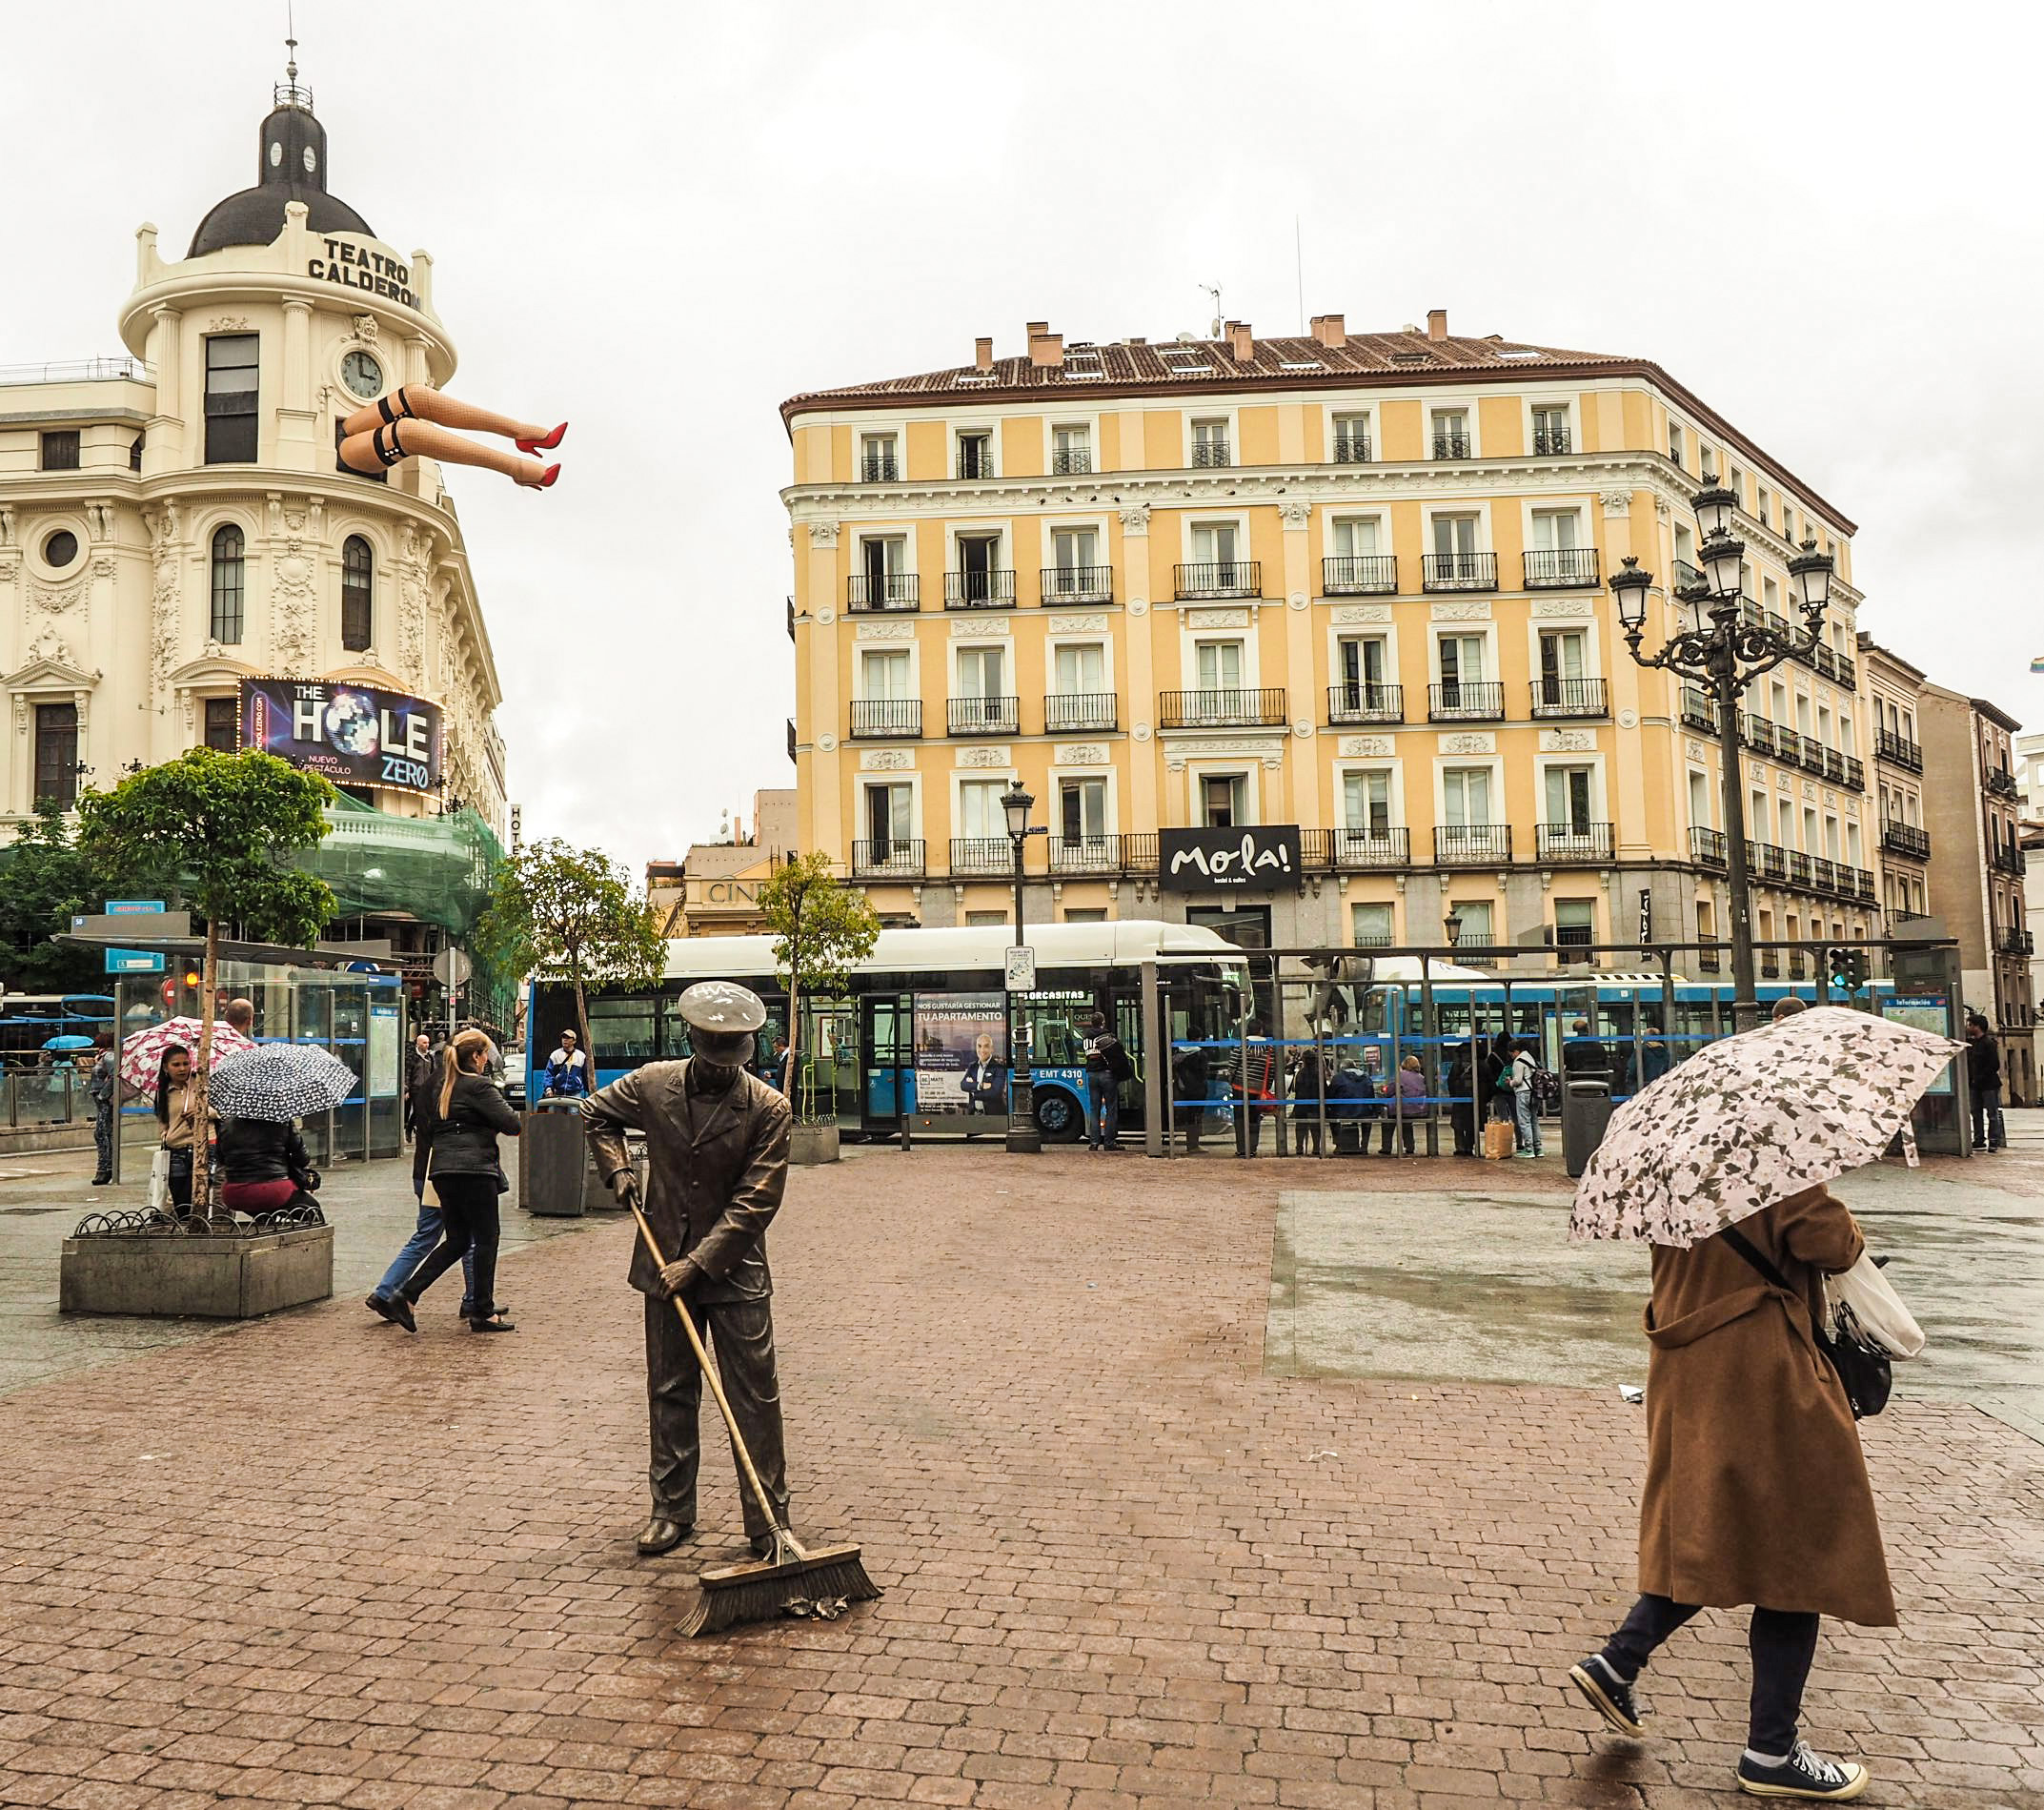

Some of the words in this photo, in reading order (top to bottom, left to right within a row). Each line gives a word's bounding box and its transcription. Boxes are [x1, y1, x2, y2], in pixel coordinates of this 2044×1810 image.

[324, 238, 408, 285] TEATRO
[309, 259, 420, 311] CALDERON
[294, 686, 323, 700] THE
[293, 694, 429, 763] HOLE
[302, 764, 351, 775] PECTÁCULO
[309, 755, 337, 763] NUEVO
[381, 756, 429, 789] ZERO
[511, 807, 520, 855] HOTE
[1170, 833, 1291, 876] Mola!
[1029, 991, 1084, 1000] ORCASITAS
[918, 1012, 930, 1022] TU
[932, 1011, 1002, 1021] APARTAMENTO
